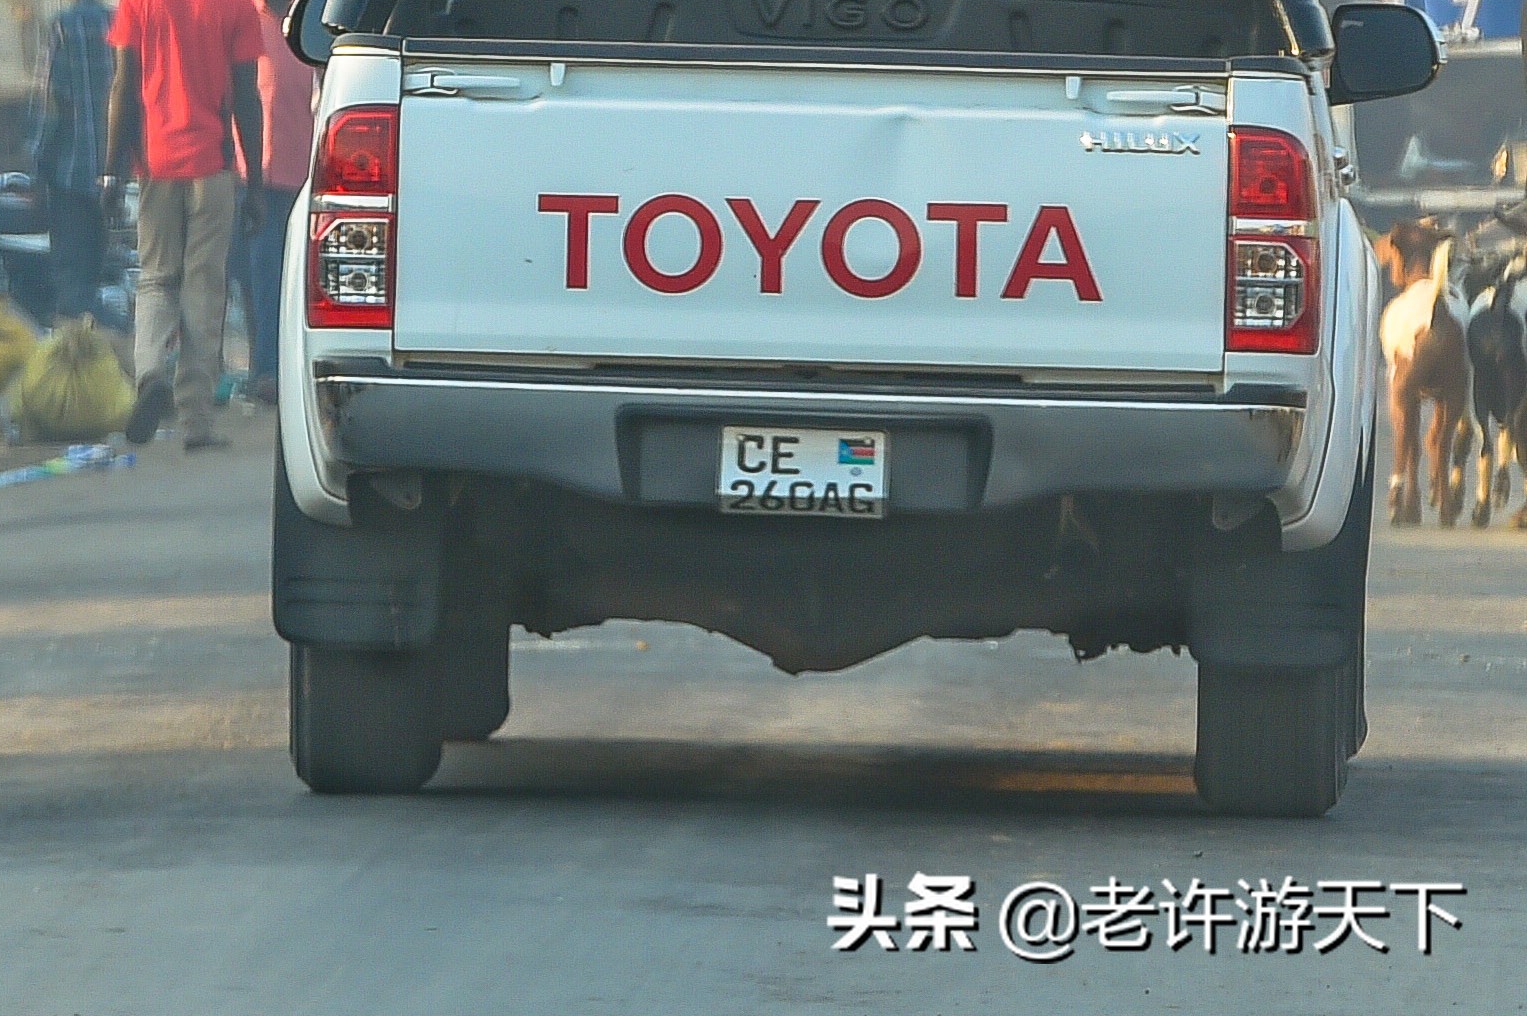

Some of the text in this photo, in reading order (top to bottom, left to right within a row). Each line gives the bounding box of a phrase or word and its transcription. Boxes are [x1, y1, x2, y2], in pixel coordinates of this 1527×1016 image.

[1079, 130, 1202, 155] HILUX
[538, 195, 1102, 302] TOYOTA
[737, 435, 801, 475] CE
[730, 480, 875, 514] 260AG
